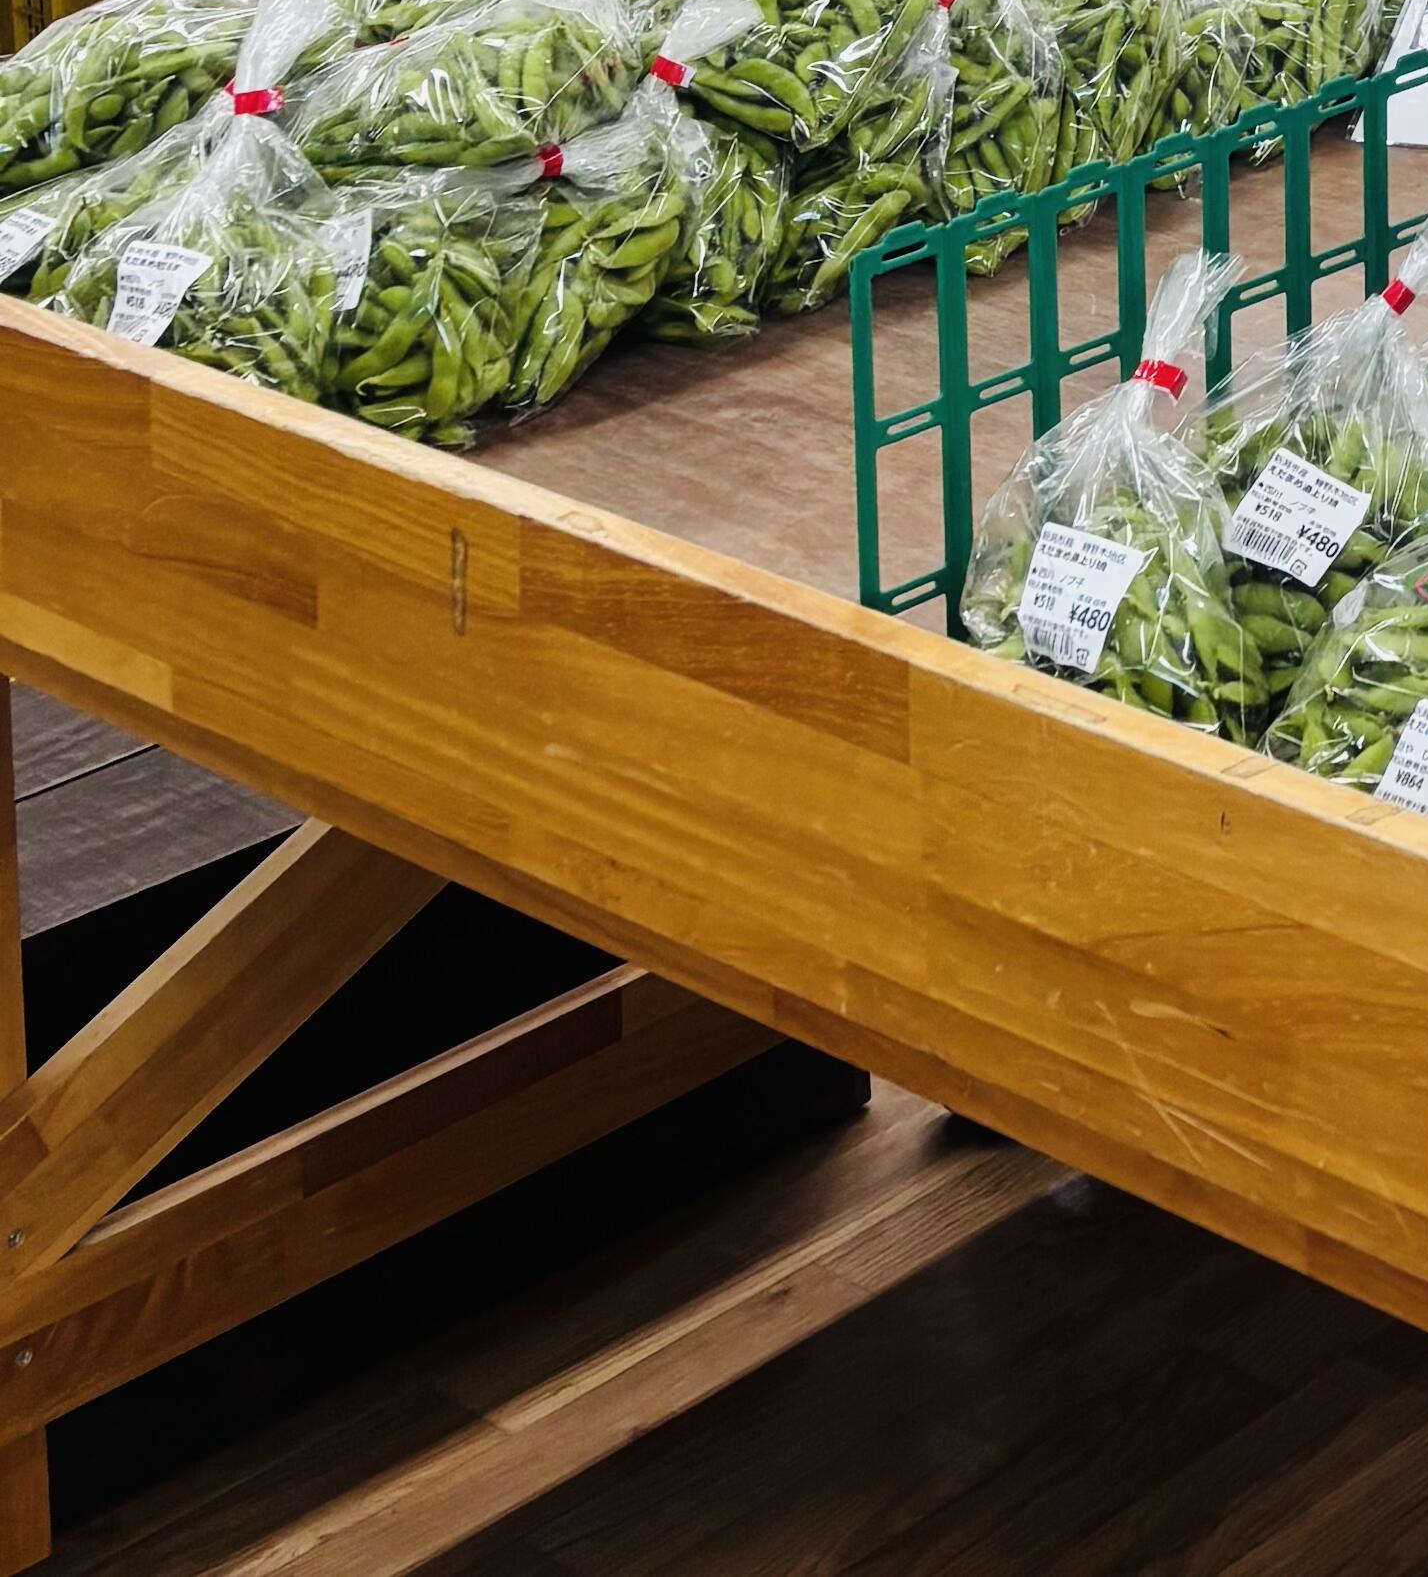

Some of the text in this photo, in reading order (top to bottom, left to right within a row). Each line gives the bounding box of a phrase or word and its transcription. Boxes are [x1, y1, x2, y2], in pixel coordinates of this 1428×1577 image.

[1255, 503, 1283, 522] ¥518
[1297, 525, 1340, 558] ¥480
[1069, 603, 1112, 632] ¥480
[1394, 769, 1425, 793] ¥864
